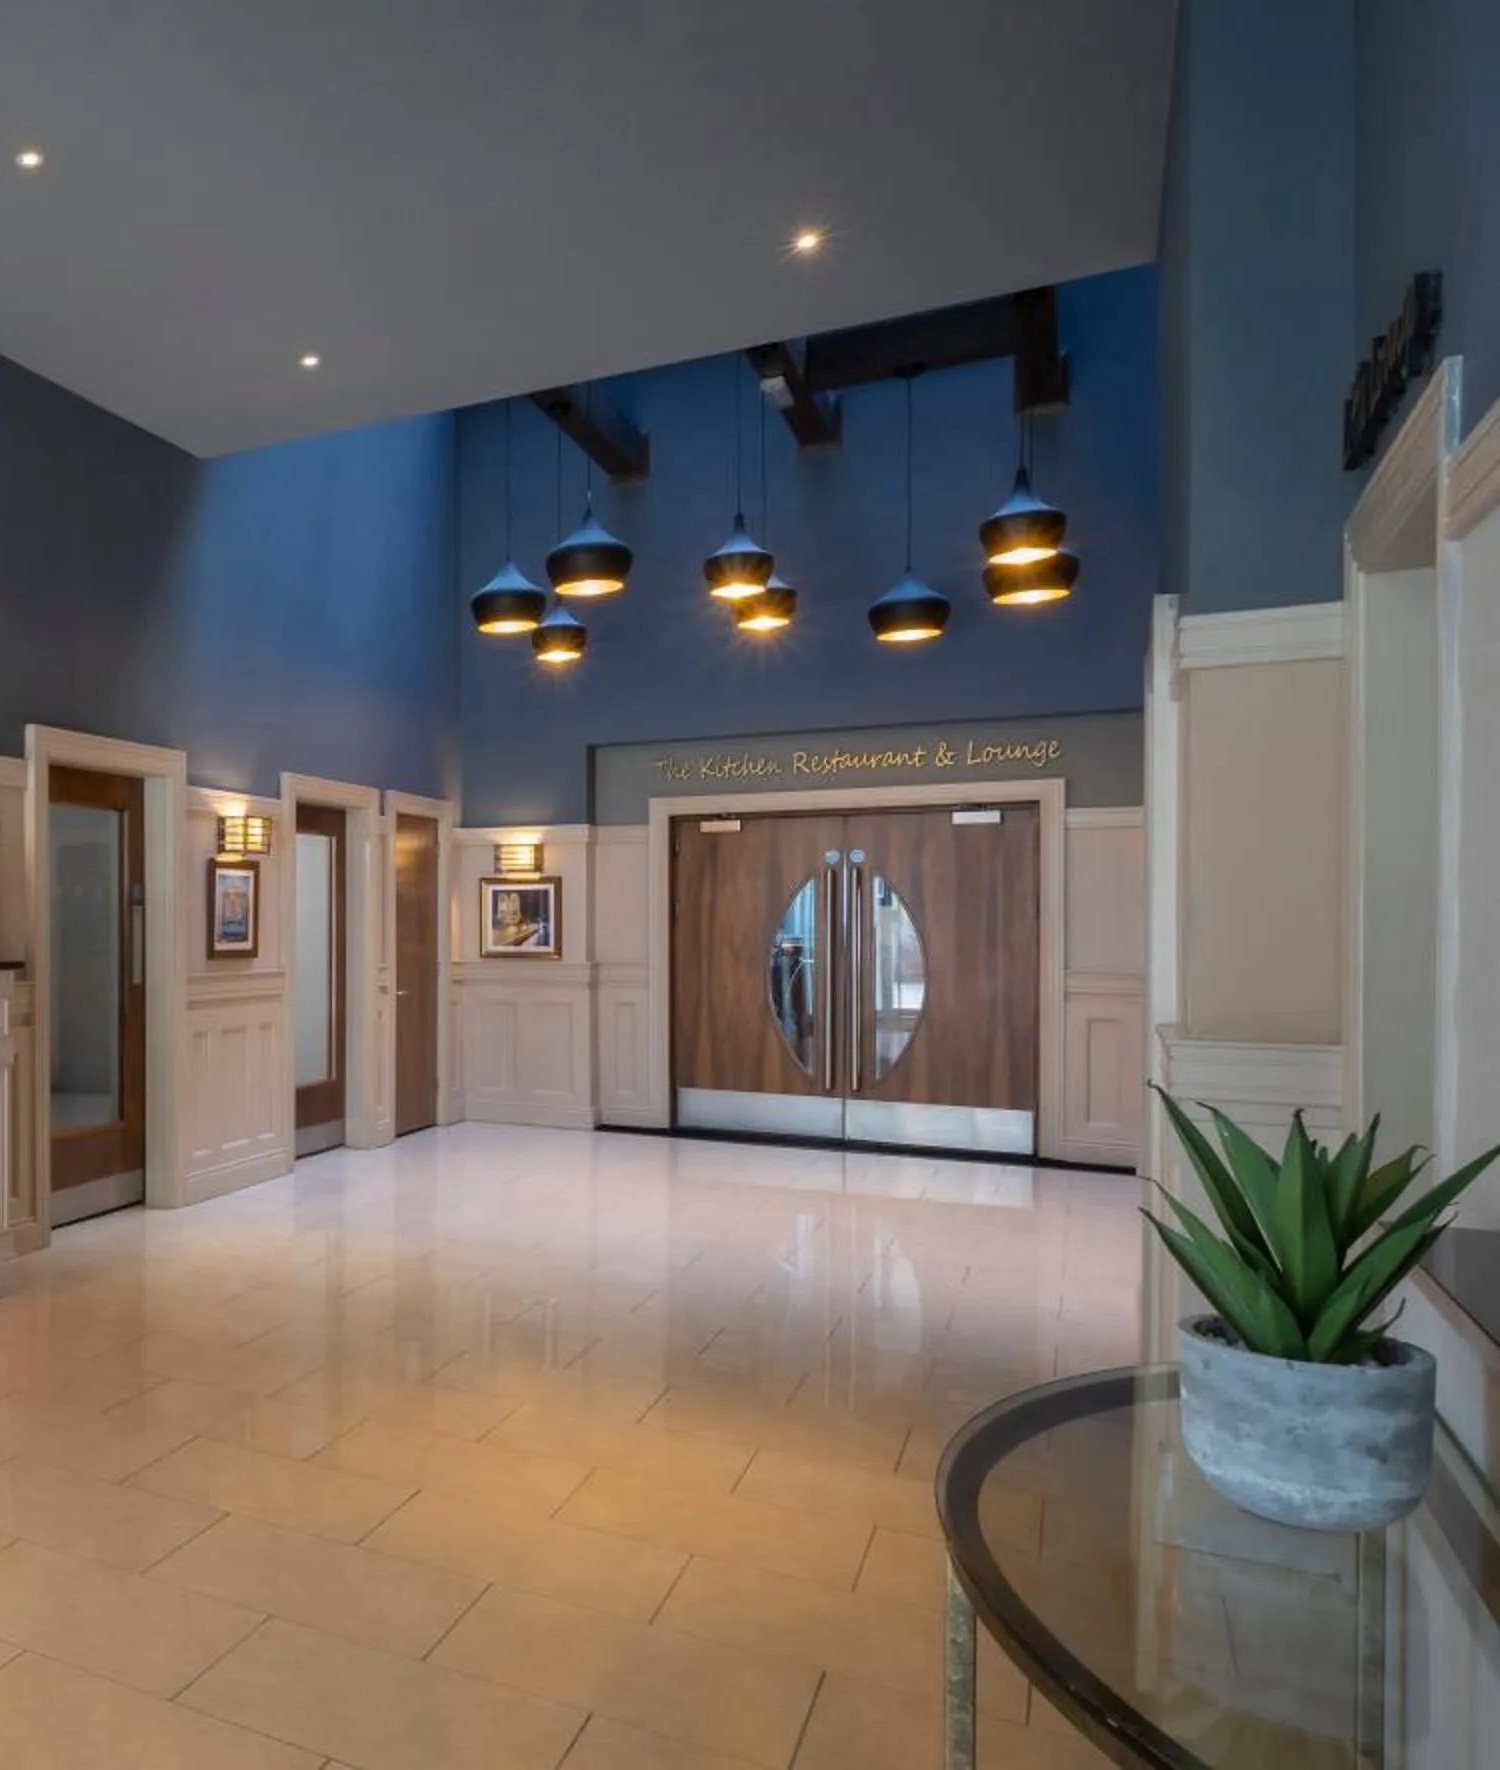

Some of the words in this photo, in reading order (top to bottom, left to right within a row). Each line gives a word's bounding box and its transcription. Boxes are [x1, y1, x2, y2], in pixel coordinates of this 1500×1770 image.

[654, 756, 691, 782] The
[701, 752, 782, 780] Kitchen
[792, 746, 926, 774] Restaurant
[935, 741, 956, 767] &
[966, 739, 1061, 767] Lounge
